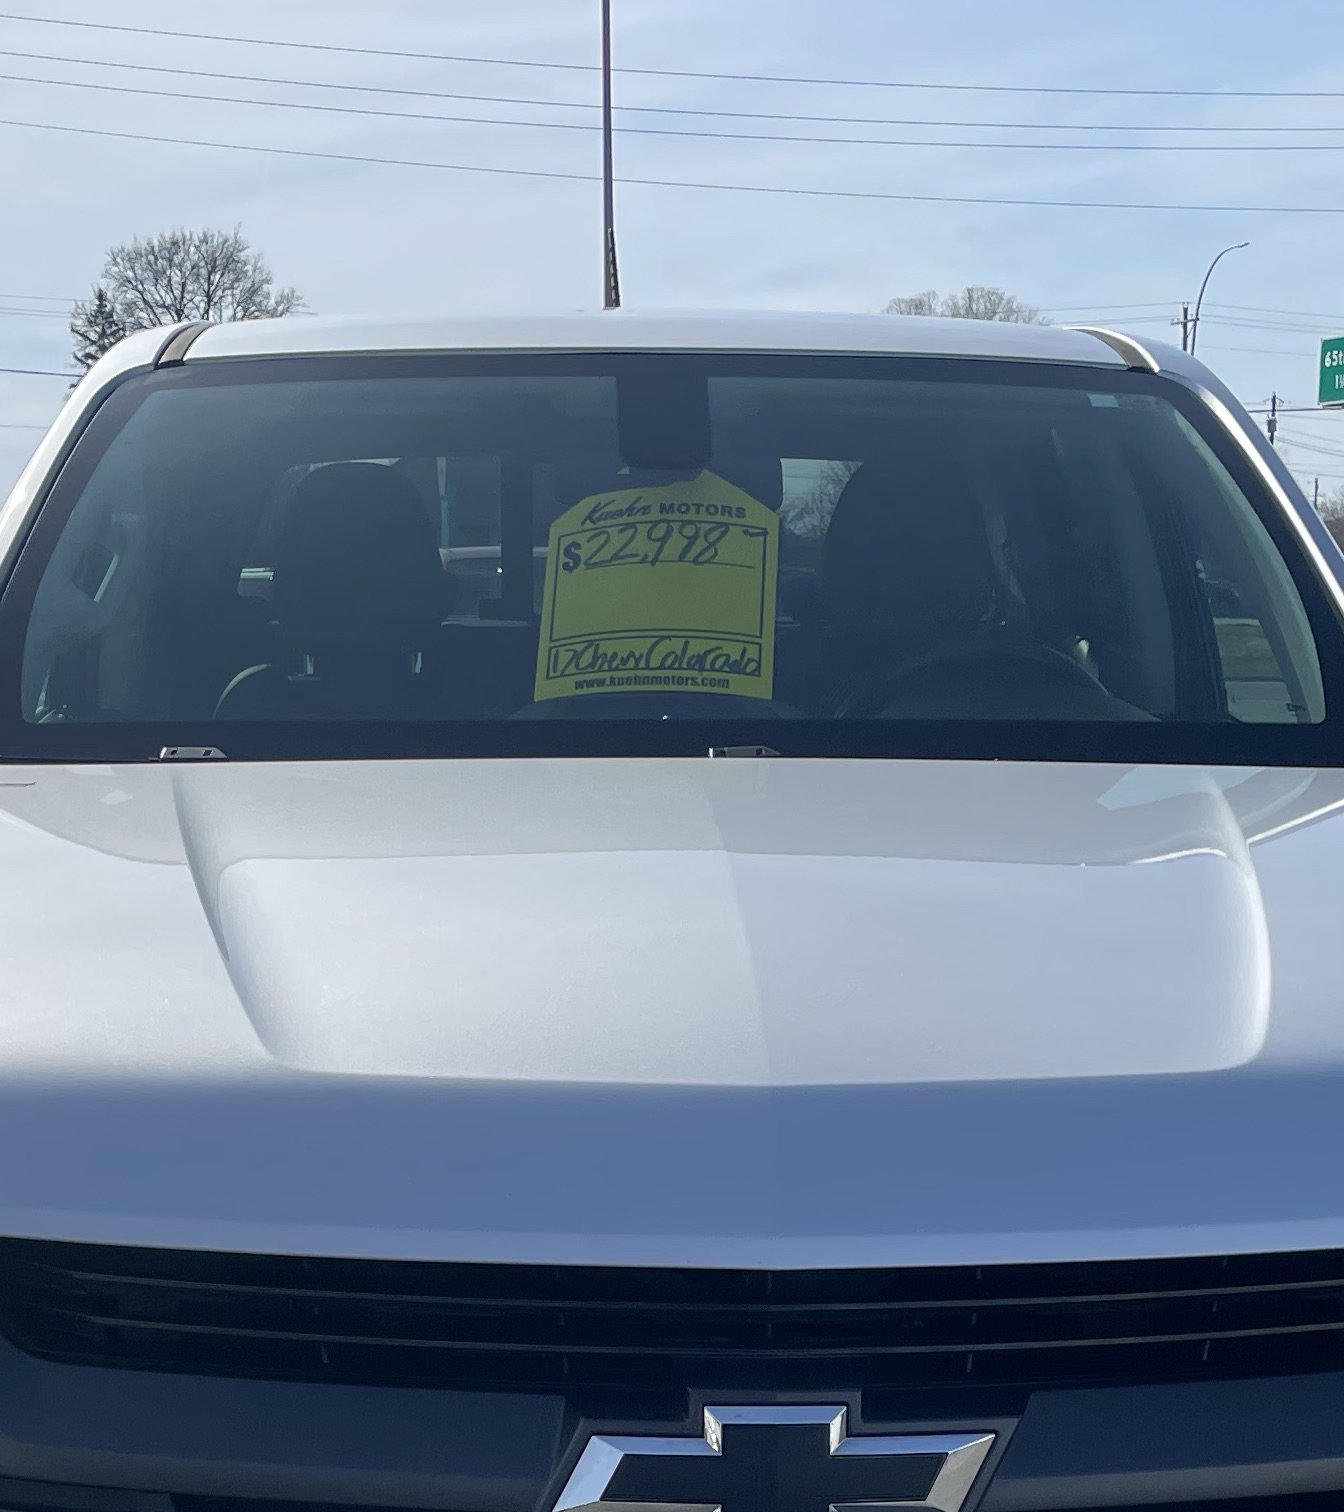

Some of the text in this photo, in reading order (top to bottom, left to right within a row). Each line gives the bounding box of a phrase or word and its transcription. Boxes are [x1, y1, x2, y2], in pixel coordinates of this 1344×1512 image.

[581, 496, 747, 527] Kuehn MOTORS
[575, 675, 730, 690] www.kuehnmotors.com
